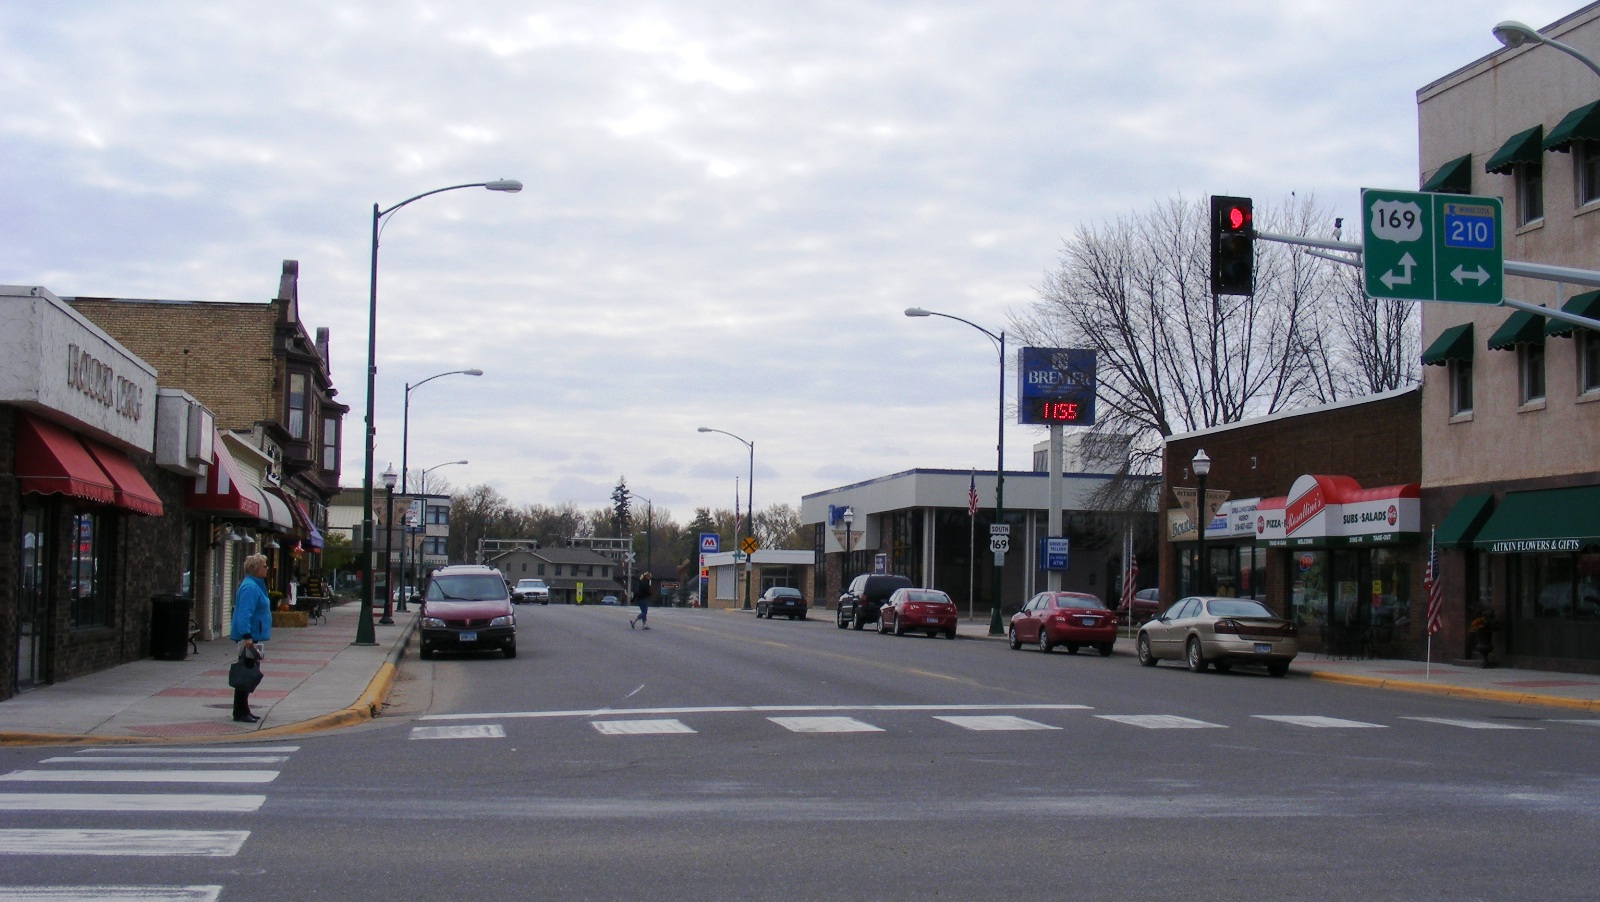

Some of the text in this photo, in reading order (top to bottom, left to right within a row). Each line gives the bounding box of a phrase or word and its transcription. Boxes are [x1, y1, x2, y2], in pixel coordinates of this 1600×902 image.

[1459, 206, 1490, 214] MINNESOTA
[1378, 208, 1415, 230] 169
[1451, 221, 1488, 242] 210
[1028, 370, 1091, 385] BREMER
[1266, 519, 1281, 528] PIZZA
[1343, 513, 1358, 524] SUBS
[1361, 511, 1387, 522] SALADS
[992, 539, 1007, 549] 169
[1491, 539, 1579, 552] AITKIN FLOWERS & GIFTS
